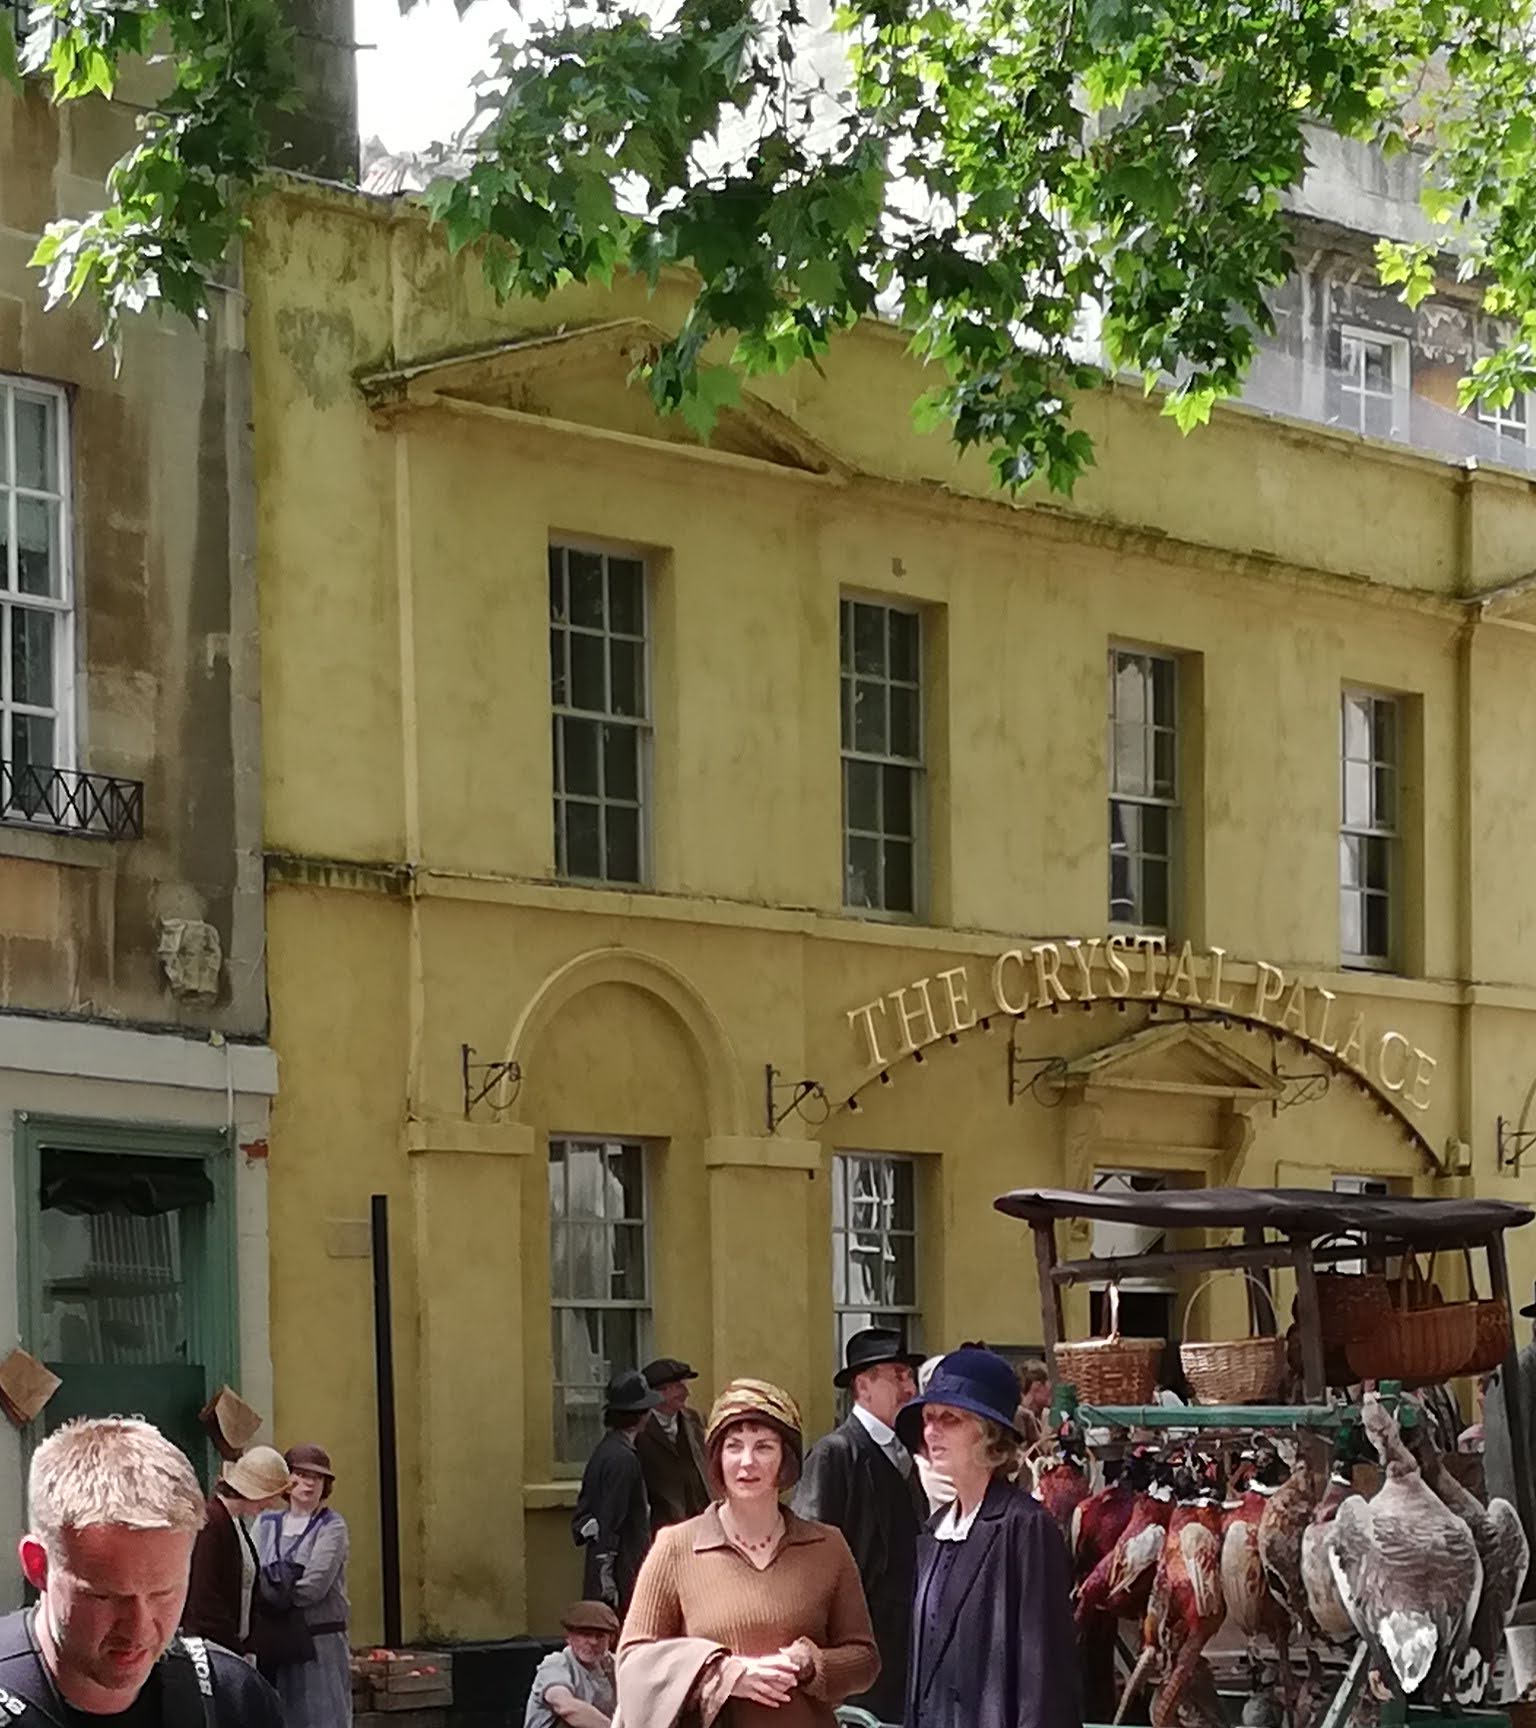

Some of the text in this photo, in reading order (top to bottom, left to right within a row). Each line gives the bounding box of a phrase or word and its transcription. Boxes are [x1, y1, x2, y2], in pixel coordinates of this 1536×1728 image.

[847, 936, 1439, 1113] THE CRYSTAL PALACE
